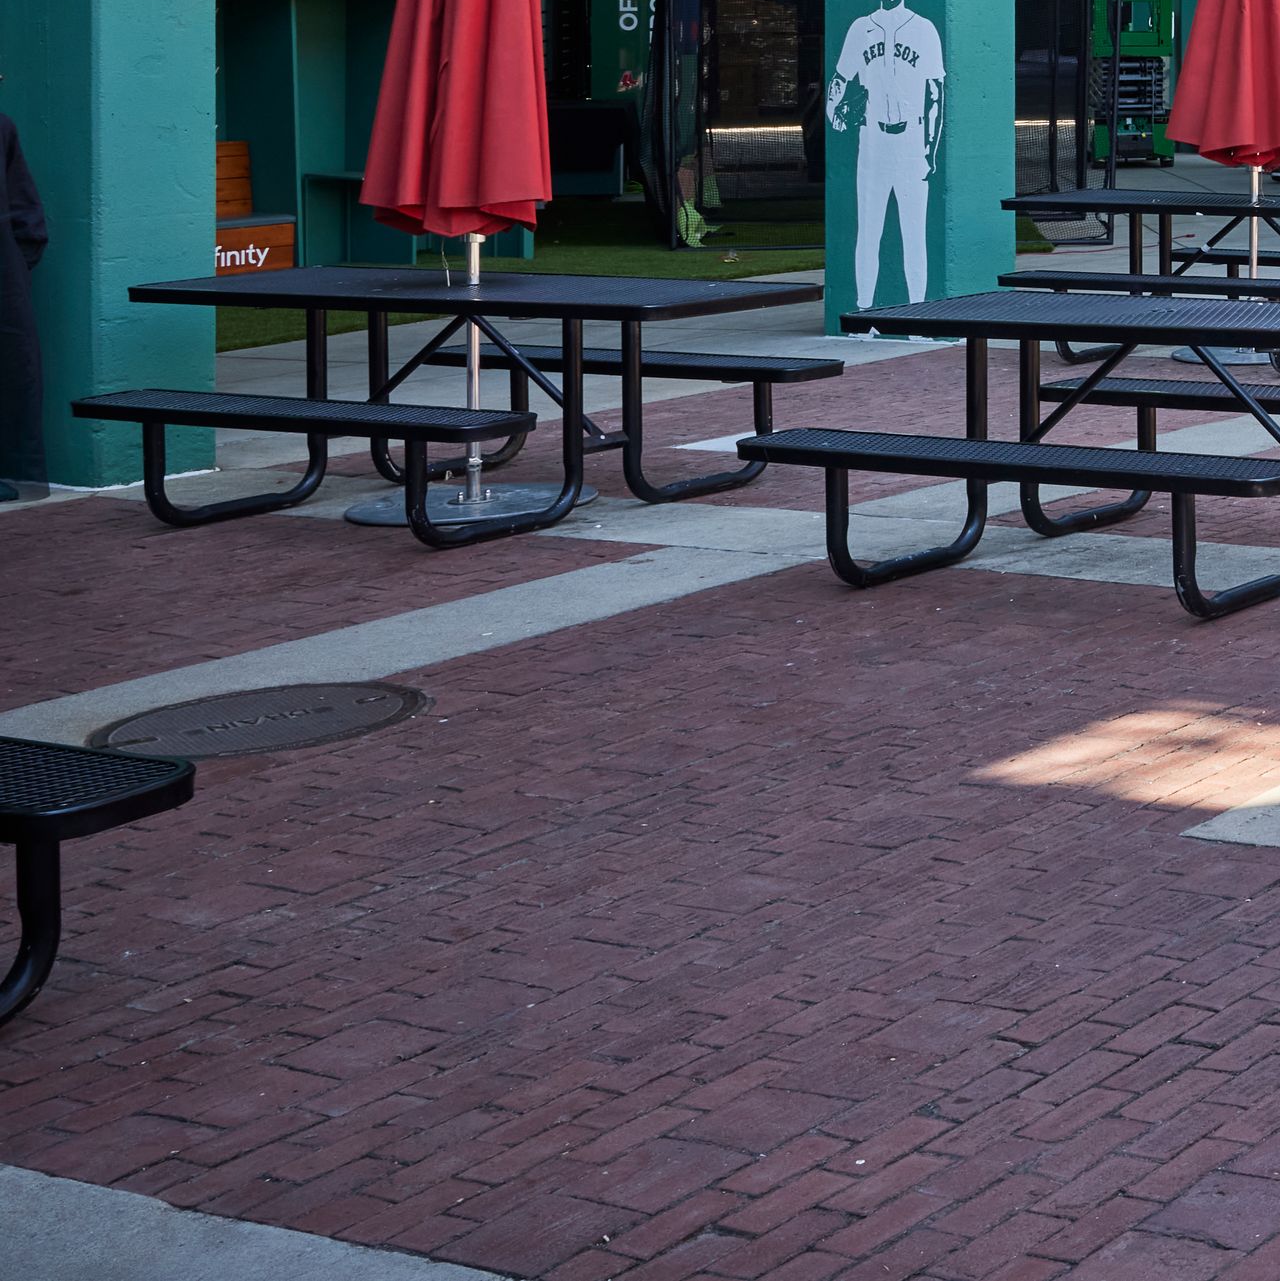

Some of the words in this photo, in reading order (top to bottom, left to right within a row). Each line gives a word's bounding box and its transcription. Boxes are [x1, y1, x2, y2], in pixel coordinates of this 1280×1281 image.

[863, 41, 885, 66] RED
[894, 43, 920, 68] SOX
[214, 243, 270, 268] finity
